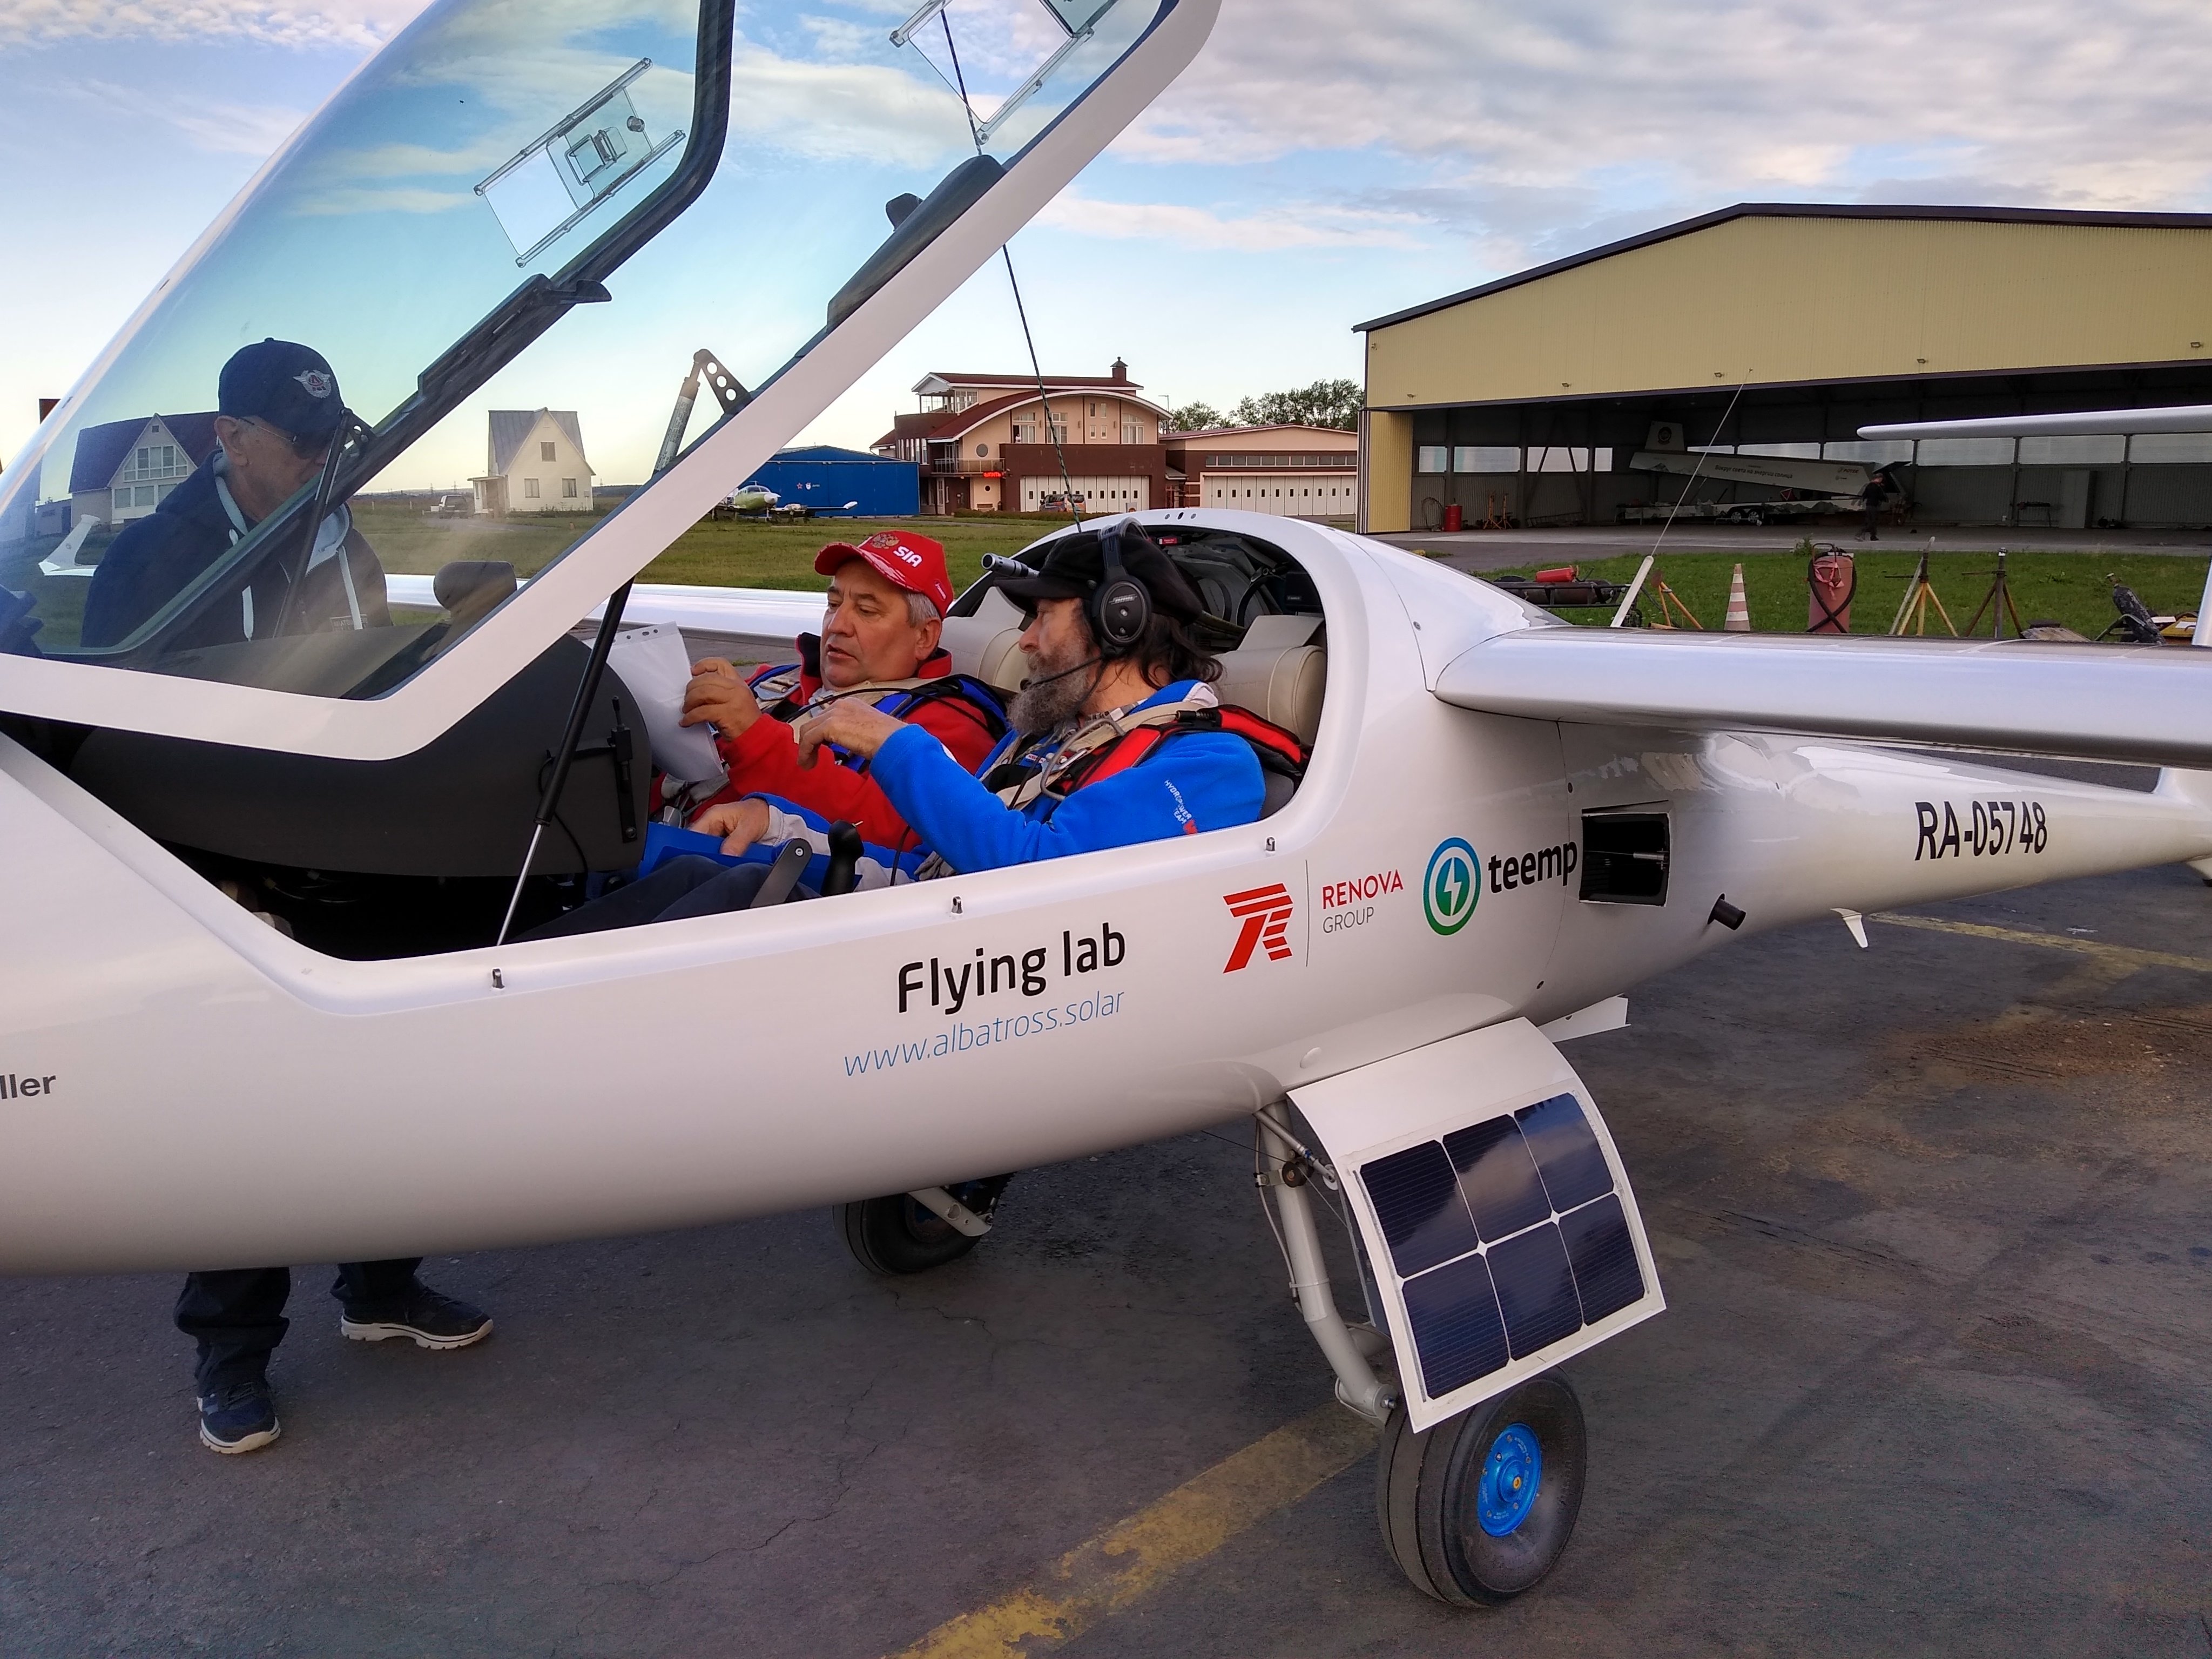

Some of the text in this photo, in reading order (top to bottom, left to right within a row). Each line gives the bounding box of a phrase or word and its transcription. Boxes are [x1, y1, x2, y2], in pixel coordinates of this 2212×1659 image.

[893, 546, 922, 568] SIA
[1164, 779, 1192, 820] HYDROPOWER
[1173, 807, 1187, 824] TEAM
[1915, 801, 2047, 860] RA-05748
[1488, 840, 1577, 893] teemp
[1323, 870, 1403, 909] RENOVA
[1323, 906, 1374, 934] GROUP
[899, 922, 1125, 1015] Flying lab
[844, 989, 1124, 1077] www.albatross.solar
